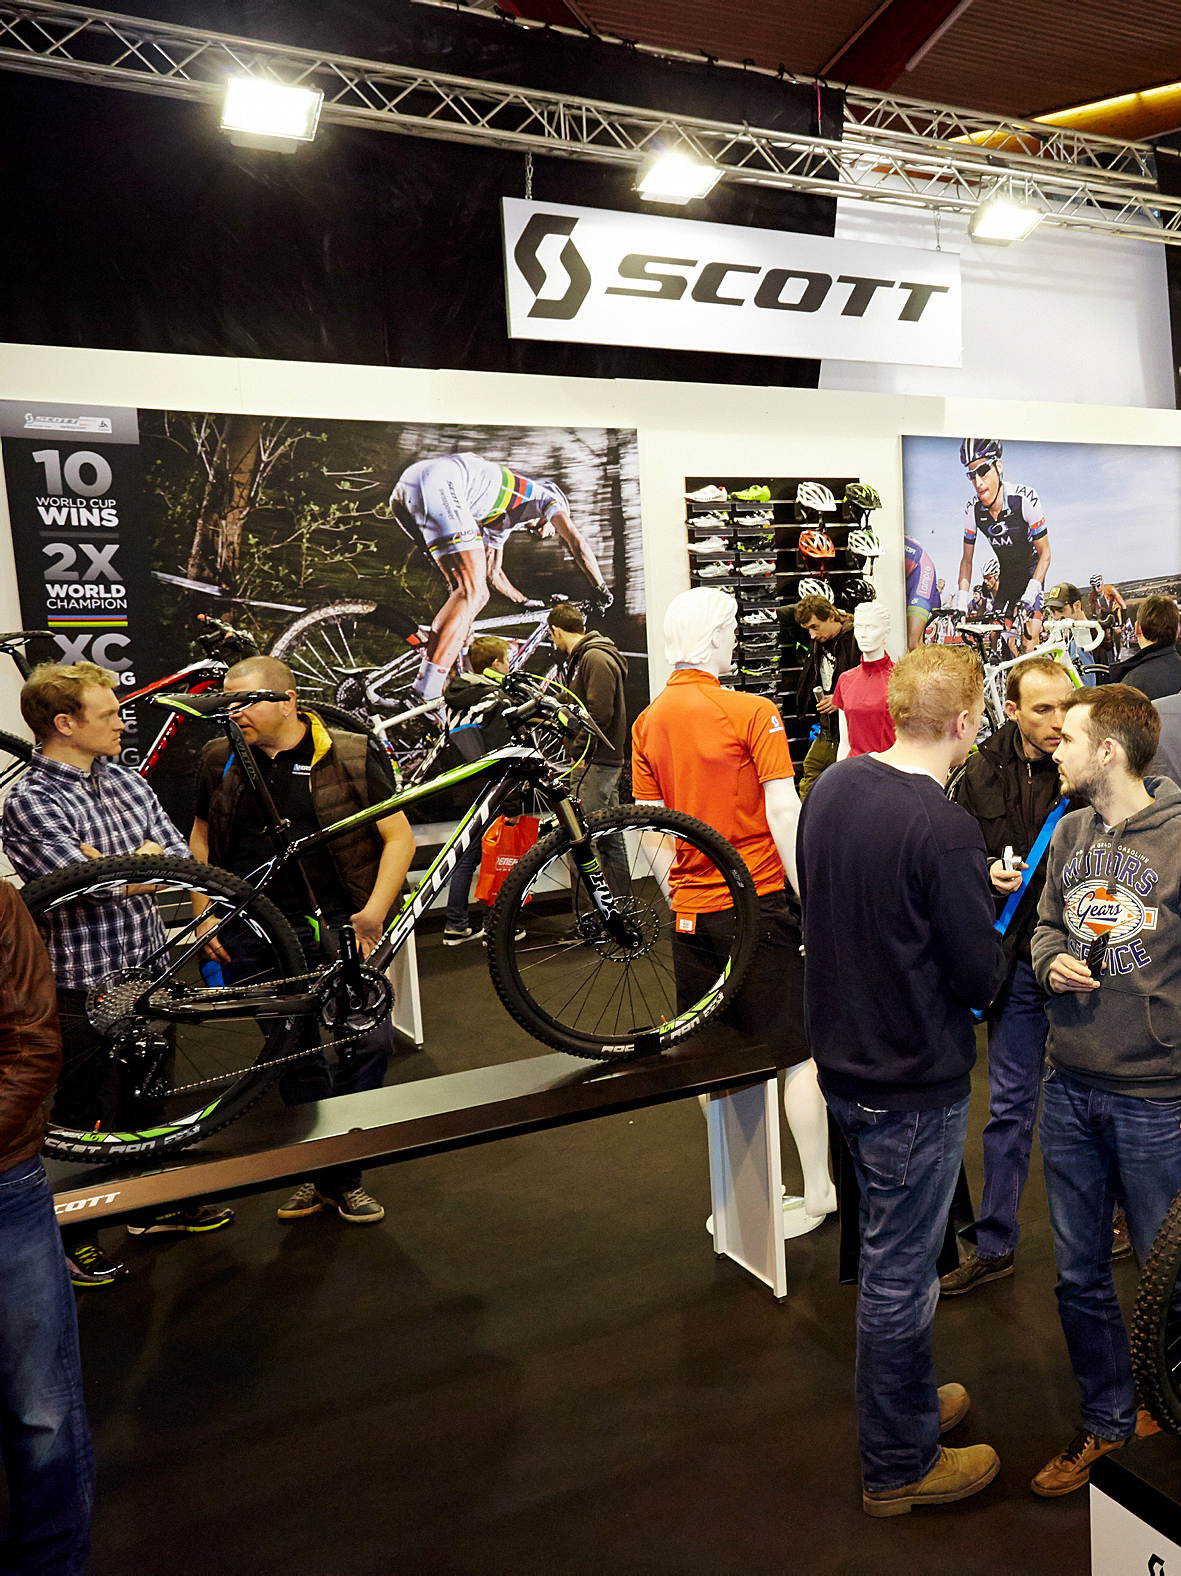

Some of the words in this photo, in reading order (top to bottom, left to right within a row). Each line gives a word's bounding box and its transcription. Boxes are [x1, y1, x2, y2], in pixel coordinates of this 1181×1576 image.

[604, 253, 950, 322] SCOTT
[32, 449, 112, 497] 10
[36, 497, 86, 506] WORLD
[90, 498, 116, 508] CUP
[37, 506, 119, 527] WINS
[42, 542, 123, 581] 2X
[45, 584, 126, 598] WORLD
[46, 599, 127, 609] CHAMPION
[53, 633, 134, 671] XC
[1077, 891, 1123, 929] Gears
[45, 1136, 102, 1154] CKET
